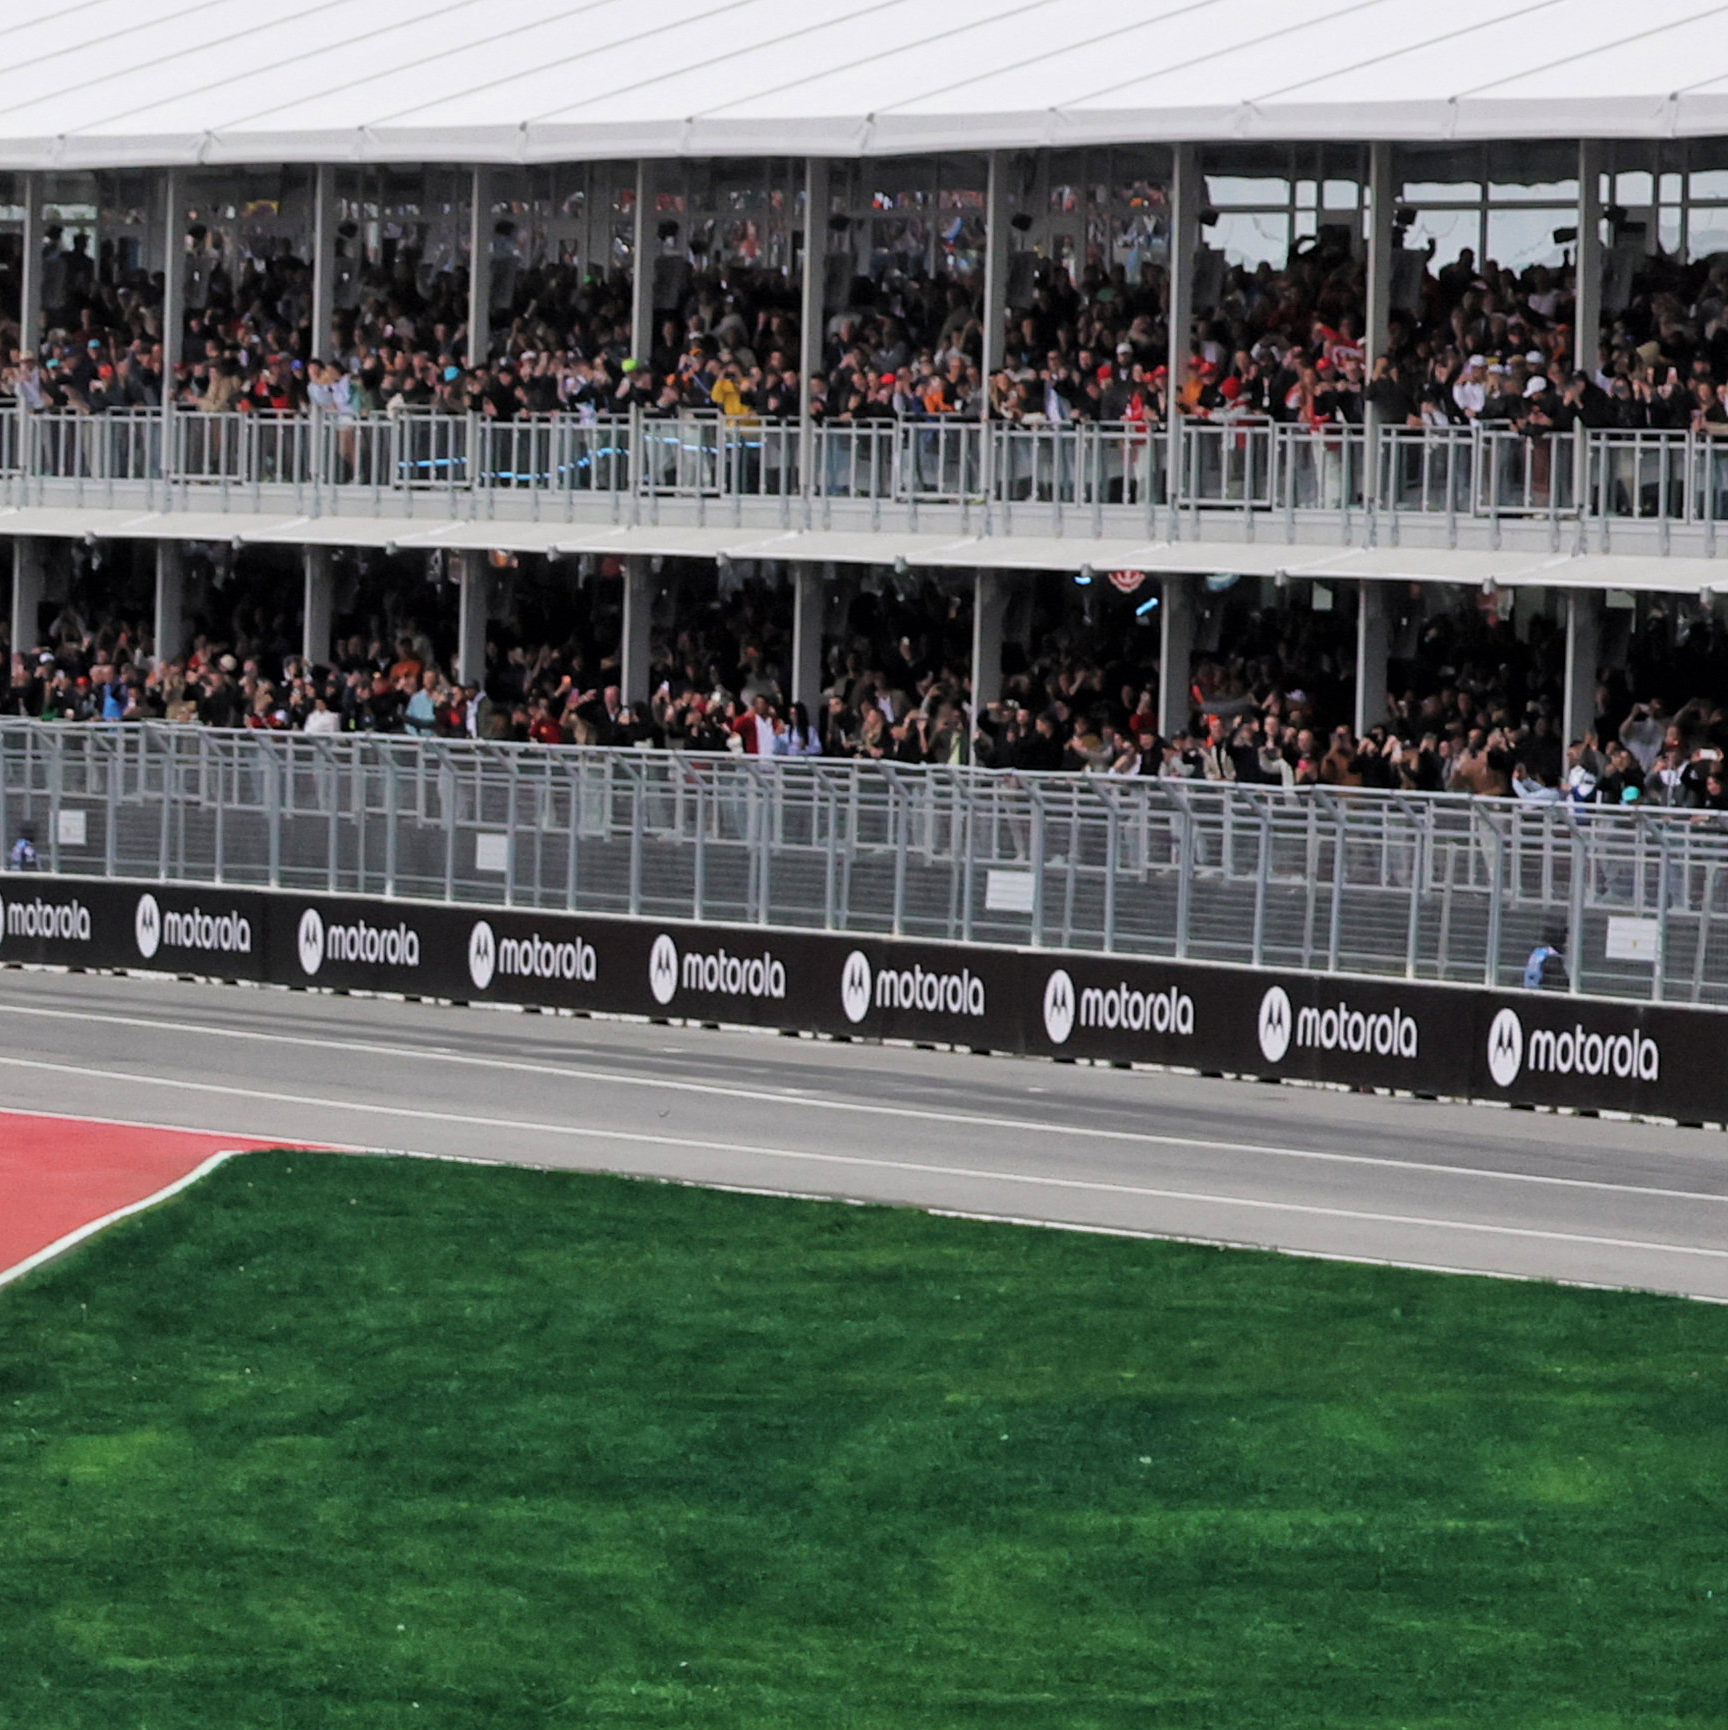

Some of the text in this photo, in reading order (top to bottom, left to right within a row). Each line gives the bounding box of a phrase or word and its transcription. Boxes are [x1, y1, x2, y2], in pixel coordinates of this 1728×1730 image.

[7, 898, 91, 940] motorola
[164, 907, 251, 953] motorola
[326, 920, 419, 966] motorola
[499, 933, 597, 981] motorola
[683, 948, 785, 999] motorola
[875, 964, 984, 1016] motorola
[1080, 981, 1194, 1035] motorola
[1297, 1002, 1417, 1058] motorola
[1528, 1023, 1659, 1081] motorola
